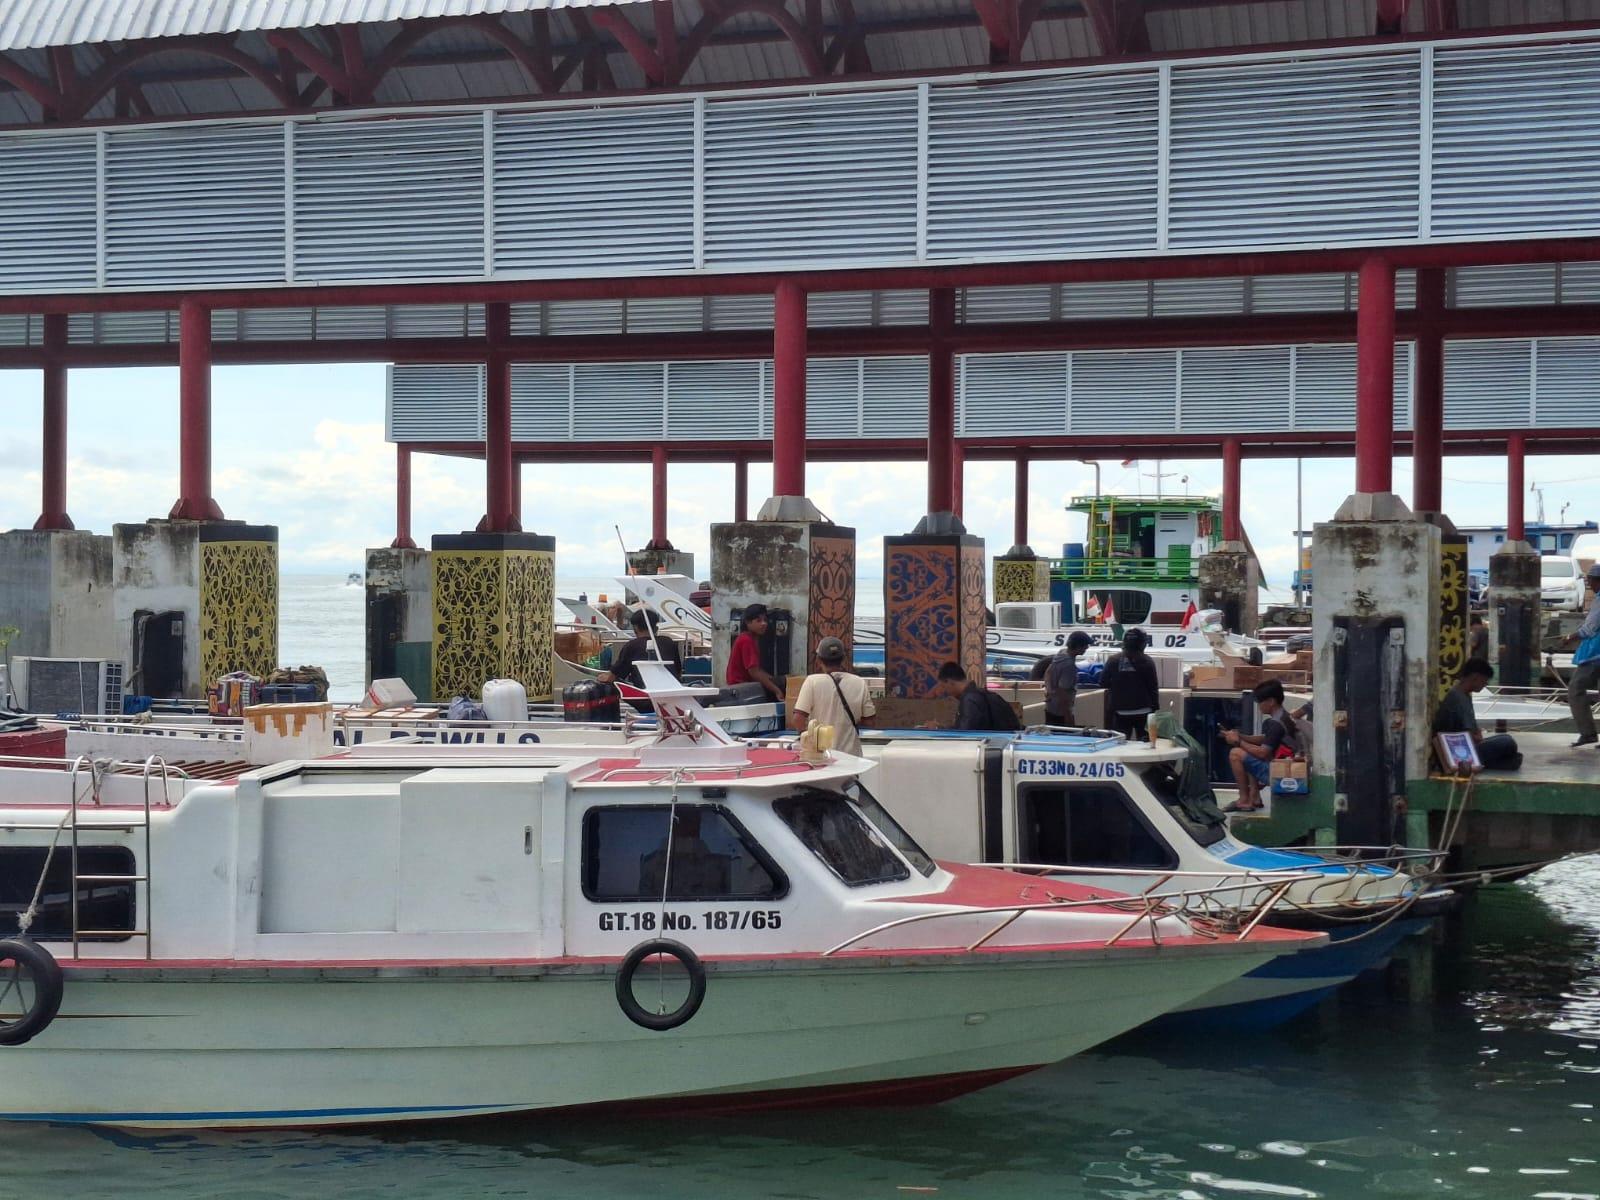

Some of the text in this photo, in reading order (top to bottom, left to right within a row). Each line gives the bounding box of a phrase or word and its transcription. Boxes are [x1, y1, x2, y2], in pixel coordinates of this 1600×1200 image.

[1164, 634, 1187, 648] 02
[598, 910, 782, 931] GT.18 No. 187/65
